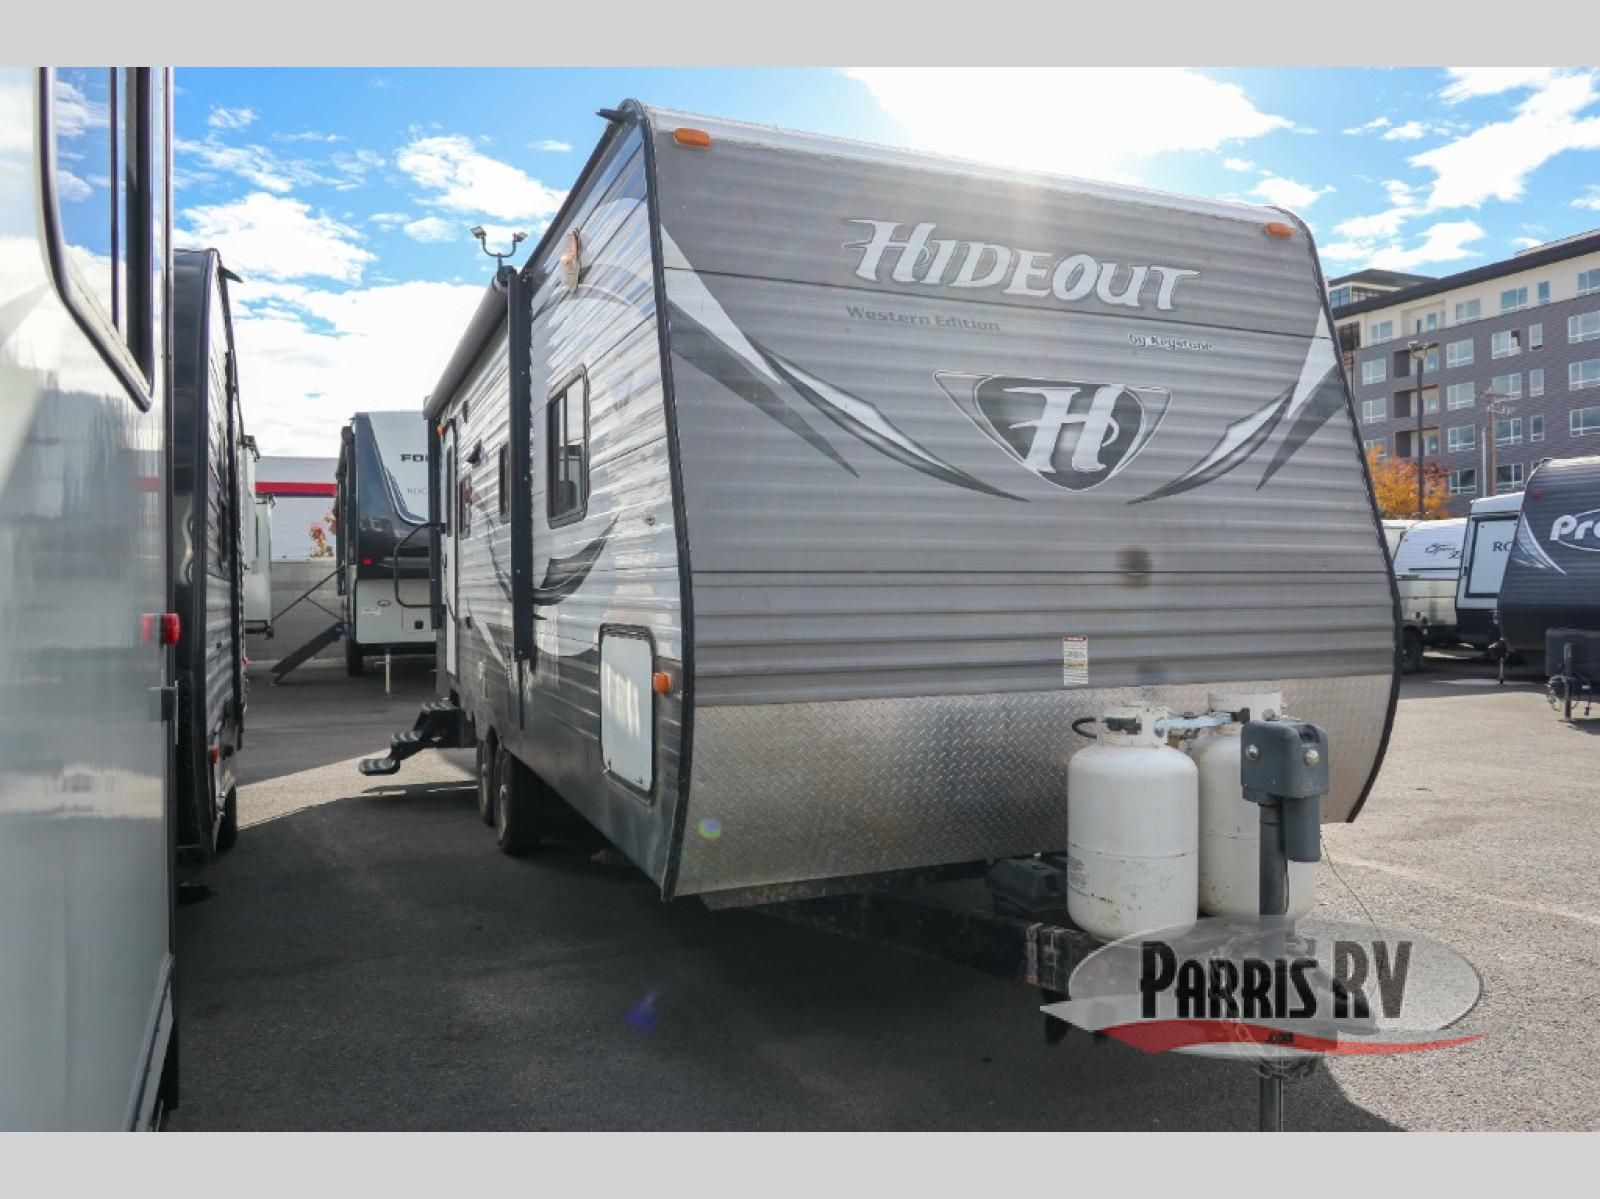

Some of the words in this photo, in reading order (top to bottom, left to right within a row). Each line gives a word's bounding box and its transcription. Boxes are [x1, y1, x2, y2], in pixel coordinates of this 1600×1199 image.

[842, 218, 1202, 311] HIDEOUT
[846, 306, 930, 325] Western
[935, 315, 1000, 331] Edition
[1127, 331, 1146, 347] by
[1150, 335, 1214, 351] Keystone
[1003, 382, 1127, 474] H
